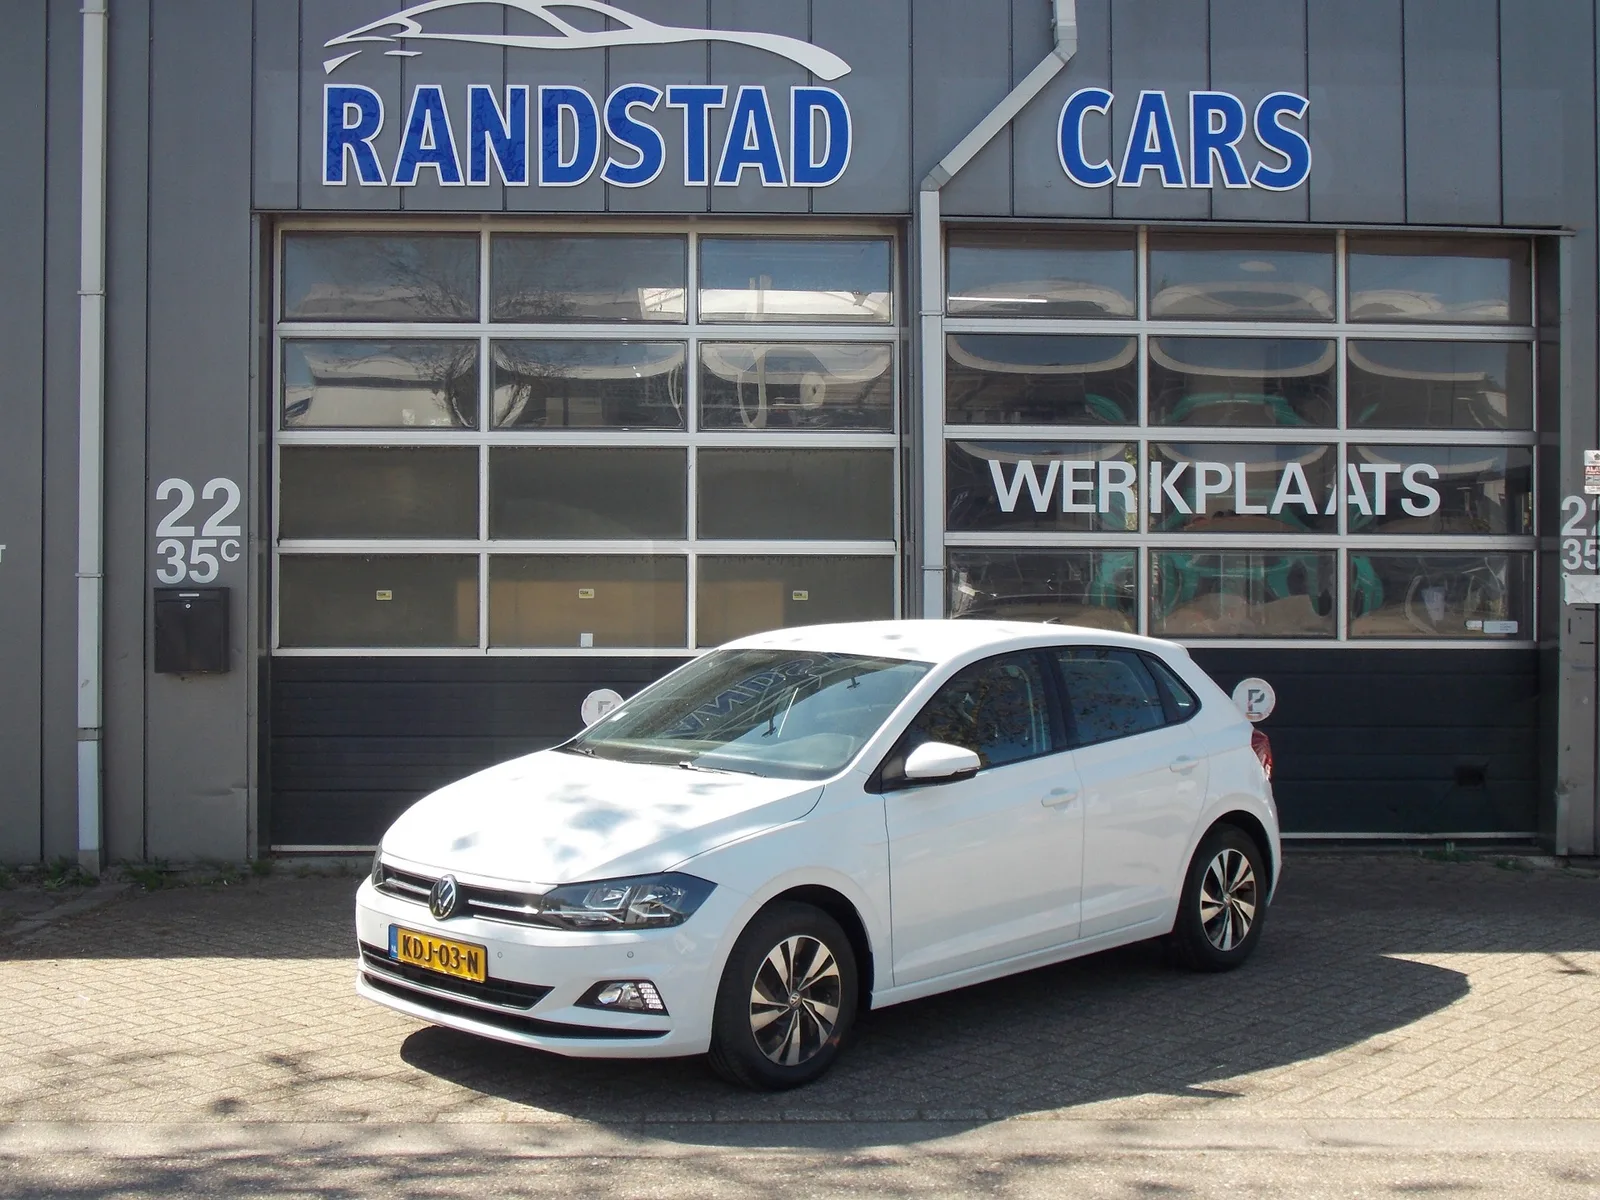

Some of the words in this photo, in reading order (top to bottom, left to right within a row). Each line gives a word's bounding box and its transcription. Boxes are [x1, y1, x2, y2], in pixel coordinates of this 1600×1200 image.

[322, 83, 853, 188] RANDSTAD
[1057, 87, 1312, 191] CARS
[156, 478, 241, 537] 22
[987, 459, 1441, 517] WERKPLAATS
[402, 934, 478, 975] KDJ-03-N
